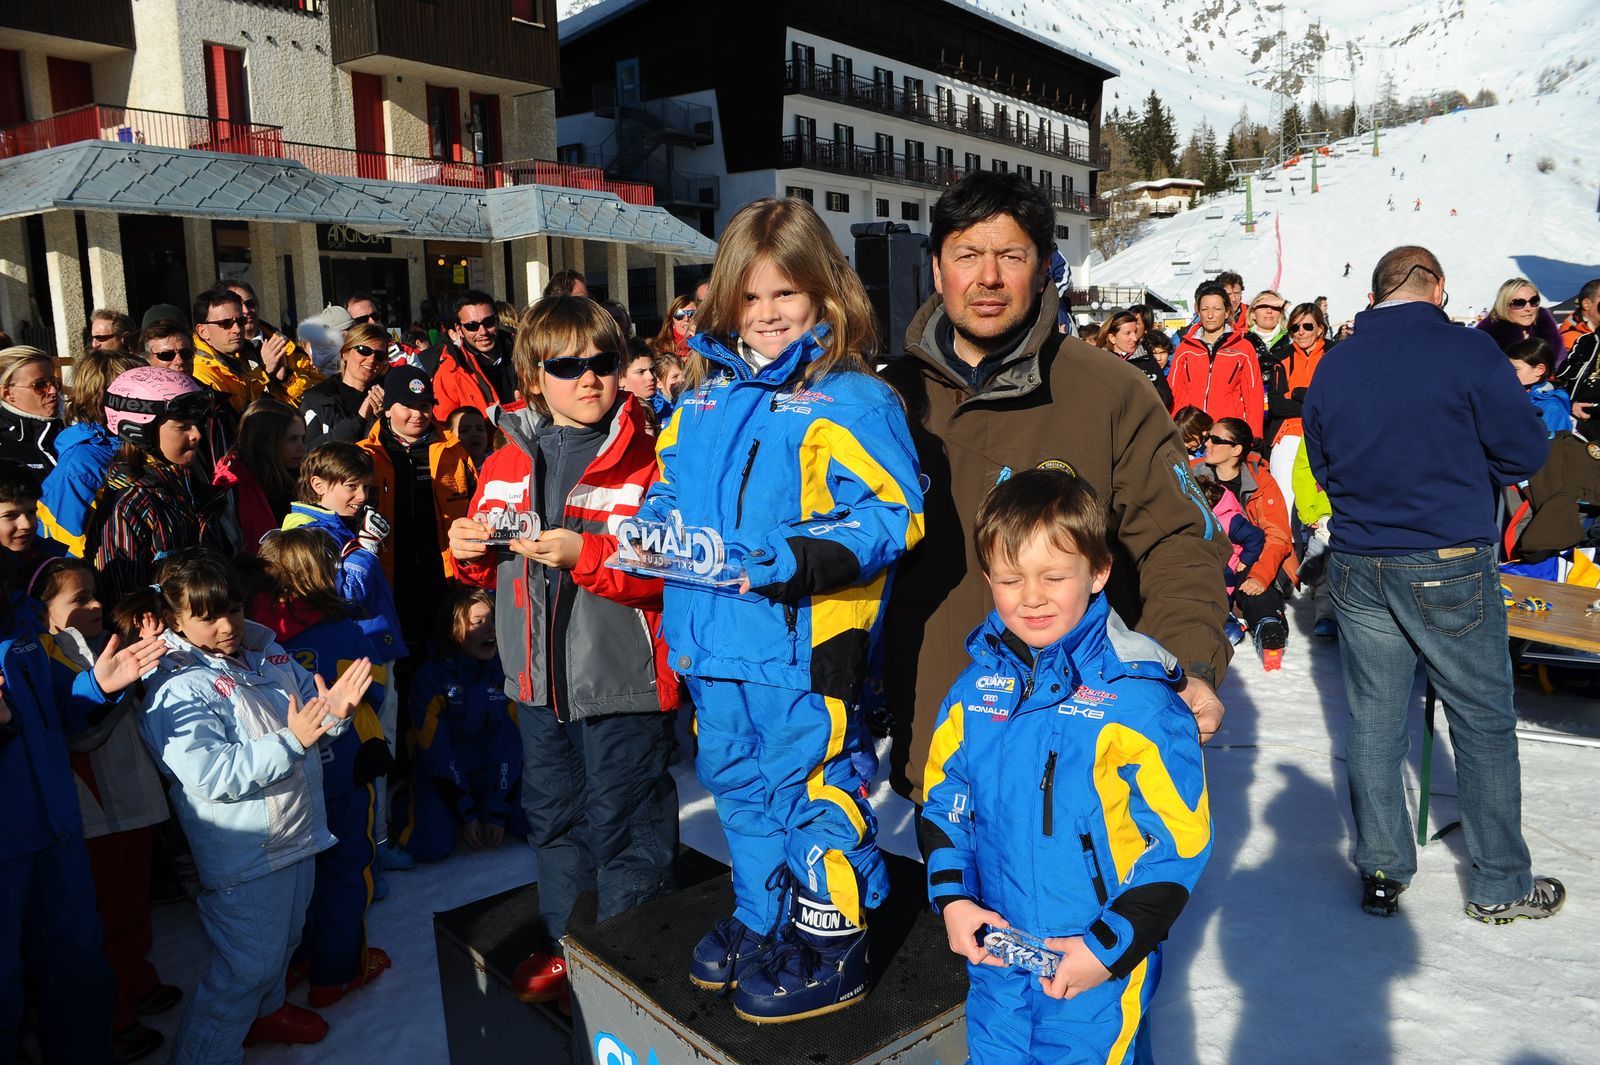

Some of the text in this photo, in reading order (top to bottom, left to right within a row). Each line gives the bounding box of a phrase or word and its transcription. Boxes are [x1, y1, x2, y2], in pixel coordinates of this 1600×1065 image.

[108, 396, 155, 413] uvex
[967, 705, 1009, 716] BONALDI
[801, 907, 841, 929] MOON
